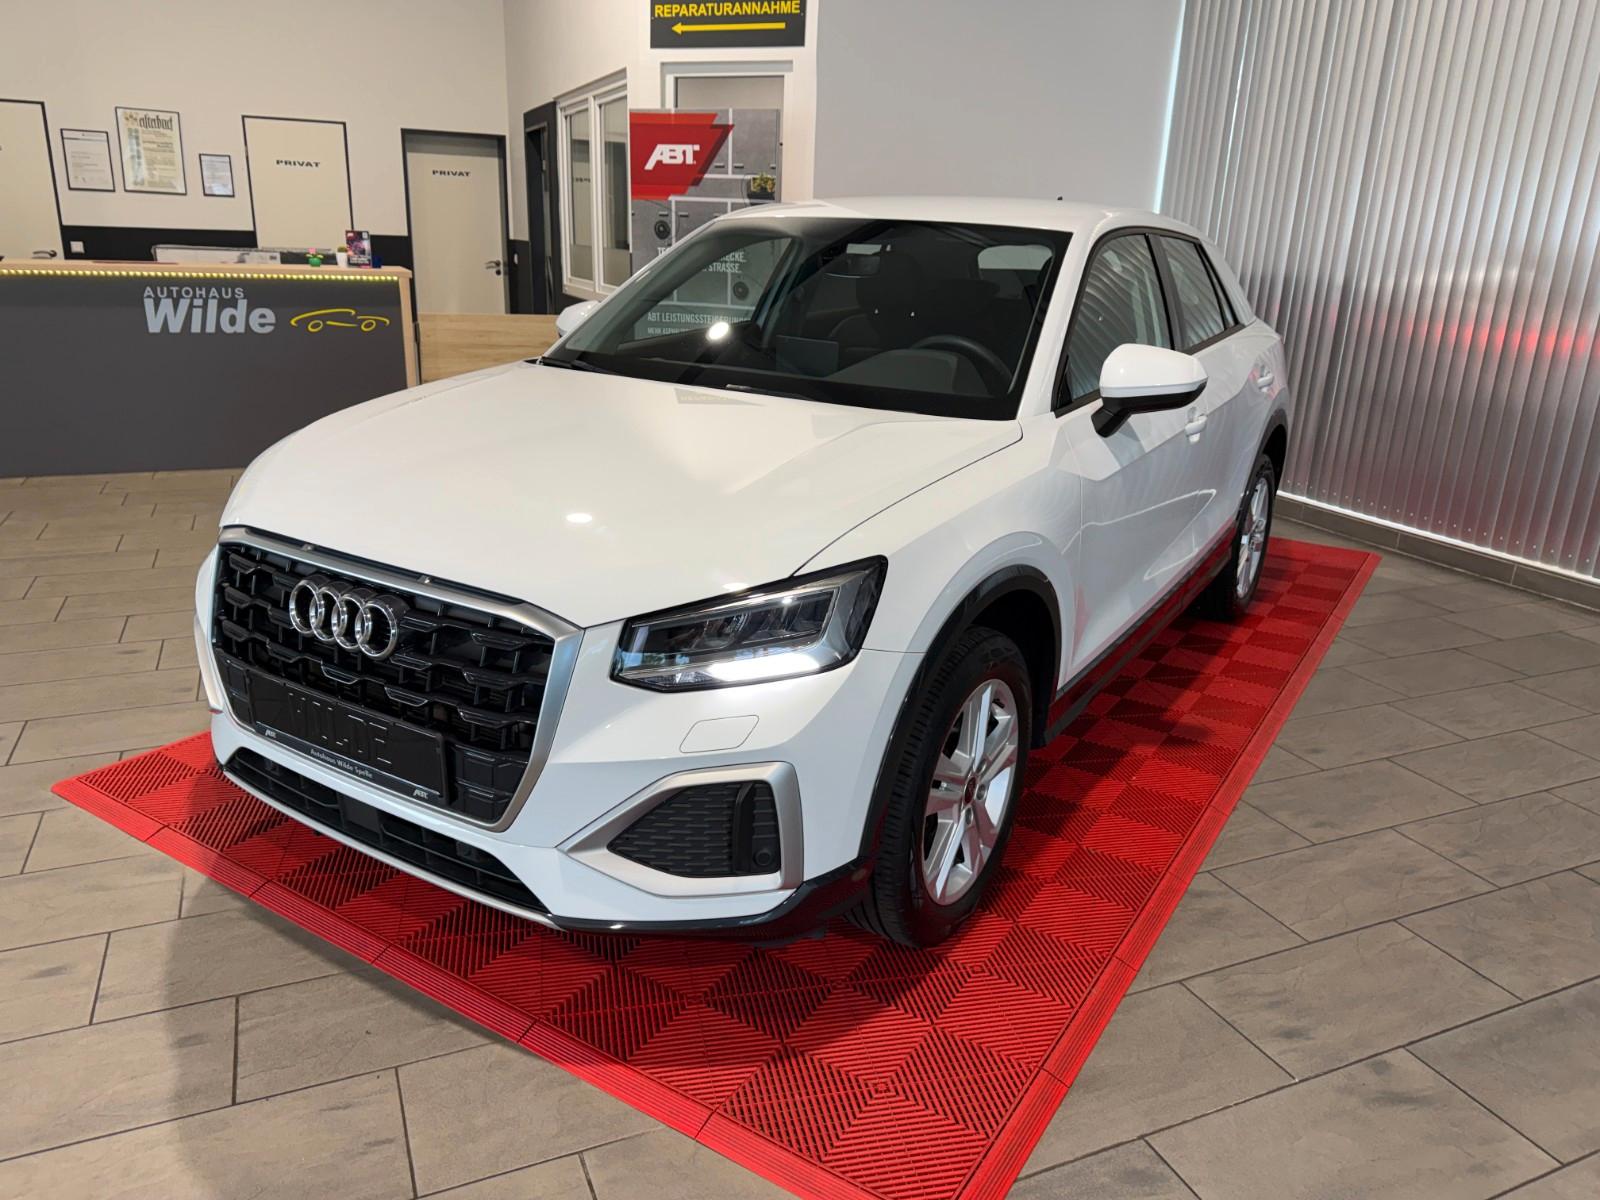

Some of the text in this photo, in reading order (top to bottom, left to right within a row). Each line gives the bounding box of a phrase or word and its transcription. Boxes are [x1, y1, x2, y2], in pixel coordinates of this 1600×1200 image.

[654, 1, 800, 17] REPARATURANNAHME
[644, 144, 700, 170] ABT
[276, 159, 320, 168] PRIVAT
[432, 169, 471, 177] PRIVAT
[143, 286, 244, 298] AUTOHAUS
[143, 297, 276, 334] Wilde
[647, 312, 660, 322] ABT
